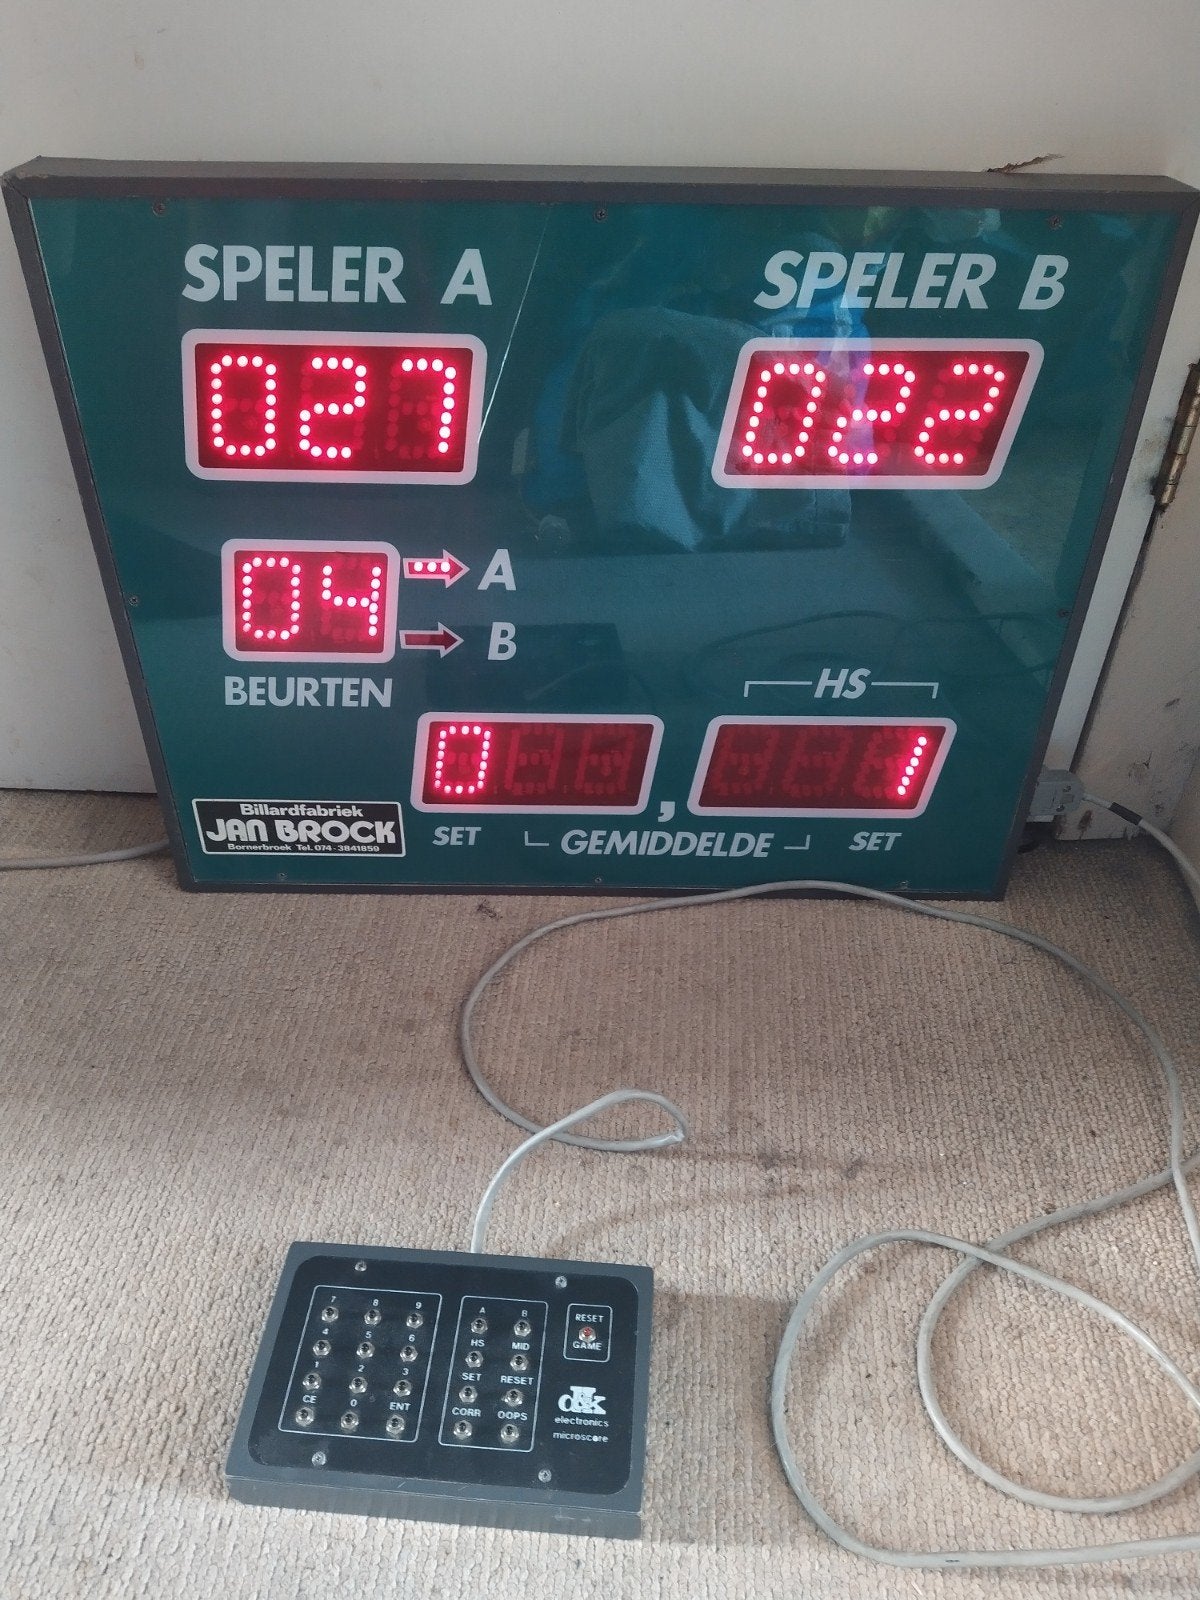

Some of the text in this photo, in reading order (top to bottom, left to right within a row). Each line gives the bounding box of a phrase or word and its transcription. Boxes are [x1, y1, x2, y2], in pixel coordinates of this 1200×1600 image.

[182, 243, 493, 306] SPELER A
[753, 250, 1069, 311] SPELER B
[209, 353, 457, 460] 027
[742, 362, 1005, 465] 022
[477, 548, 517, 591] A
[242, 556, 382, 640] 04
[487, 621, 518, 661] B
[814, 668, 871, 699] HS
[224, 676, 393, 708] BEURTEN
[239, 803, 363, 818] Billardfabriek
[205, 818, 397, 844] JAN BROCK
[432, 826, 482, 846] SET
[227, 843, 293, 851] Bornerbroek
[560, 829, 775, 858] GEMIDDELDE
[848, 831, 903, 852] SET
[372, 1299, 379, 1307] 8
[415, 1301, 422, 1310] 9
[479, 1306, 486, 1315] A
[521, 1309, 528, 1318] B
[575, 1313, 604, 1323] RESET
[365, 1331, 372, 1339] 5
[408, 1334, 416, 1342] 6
[470, 1338, 485, 1348] HS
[511, 1341, 530, 1351] MID
[572, 1340, 603, 1351] GAME
[358, 1365, 366, 1373] 2
[402, 1367, 410, 1376] 3
[461, 1372, 482, 1382] SET
[500, 1375, 534, 1386] RESET
[302, 1395, 317, 1404] CE
[389, 1402, 411, 1411] ENT
[451, 1406, 482, 1418] CORR
[497, 1411, 528, 1421] OOPS
[554, 1415, 609, 1428] electronics
[552, 1431, 609, 1443] microscore
